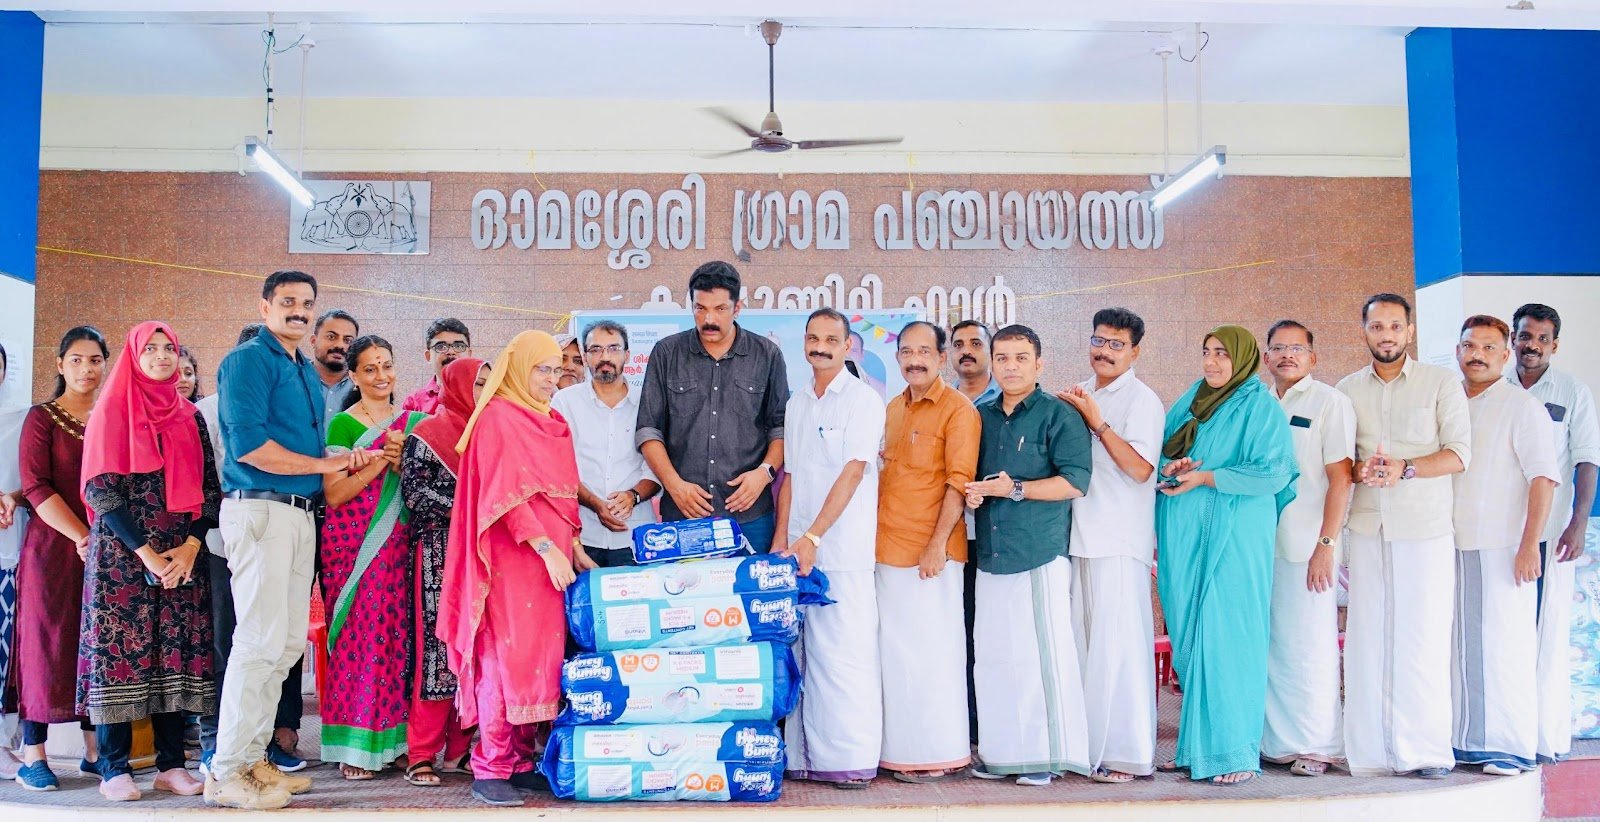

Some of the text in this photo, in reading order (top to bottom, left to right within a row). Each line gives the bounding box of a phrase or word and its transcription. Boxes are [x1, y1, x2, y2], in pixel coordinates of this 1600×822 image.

[471, 173, 706, 269] ഓമശ്ശേരി
[732, 189, 850, 262] ഗ്രാമ
[750, 562, 793, 578] Honey
[751, 597, 793, 613] Bunny
[568, 665, 613, 682] Bunny
[736, 730, 780, 748] Honey
